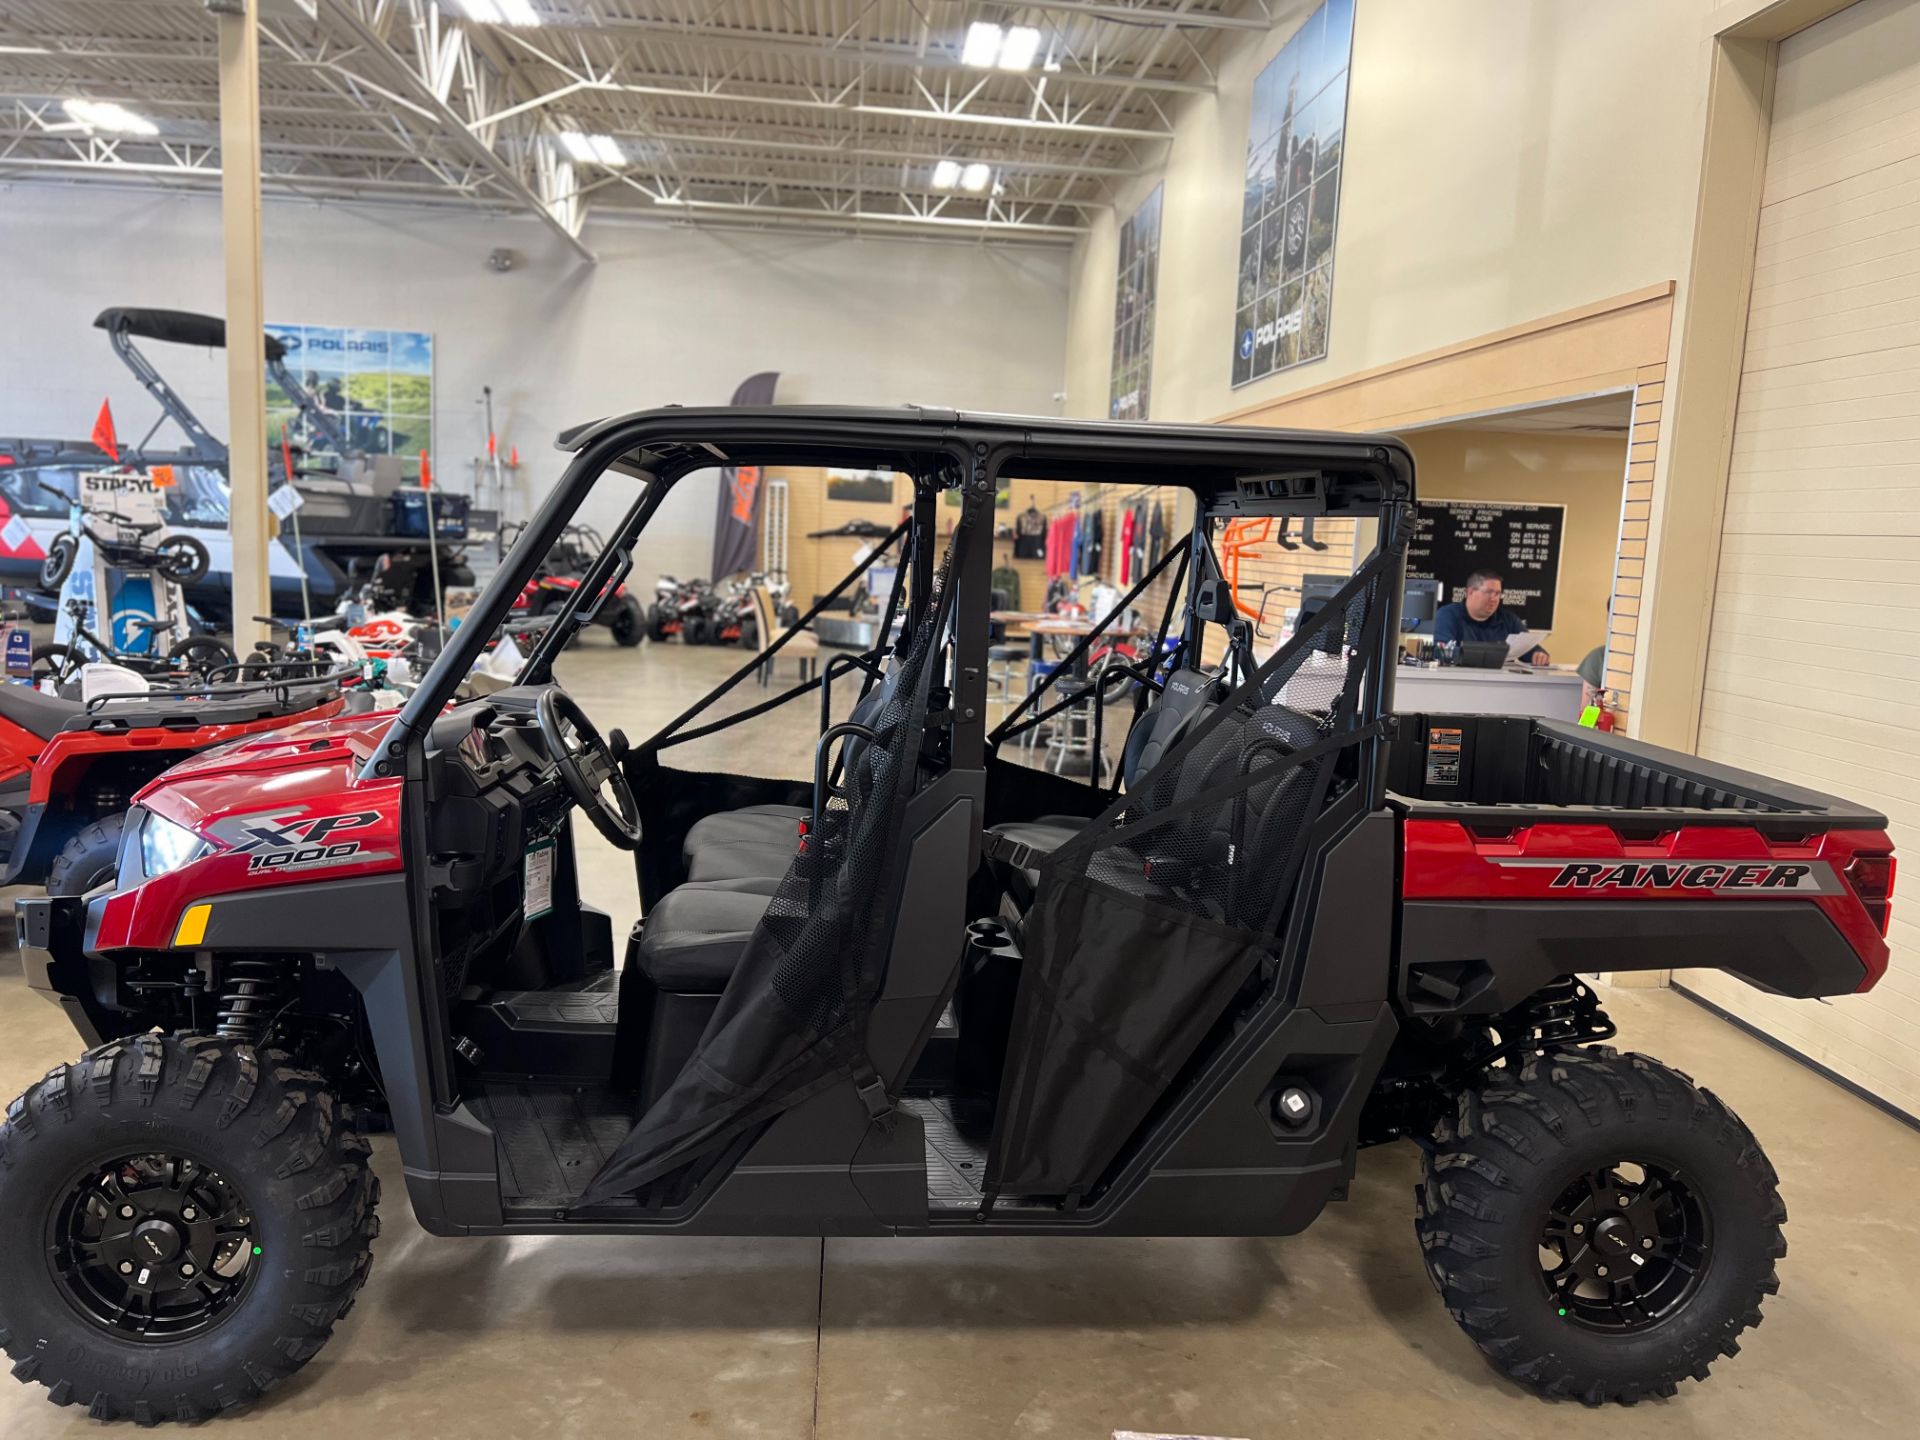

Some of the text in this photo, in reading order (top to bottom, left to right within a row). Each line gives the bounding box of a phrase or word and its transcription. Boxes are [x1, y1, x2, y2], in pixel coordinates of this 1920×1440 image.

[1256, 308, 1302, 349] POLARIS
[307, 338, 389, 353] POLARIS
[1472, 531, 1492, 539] PARTS
[1528, 562, 1542, 570] TIRE
[222, 810, 384, 855] XP
[249, 842, 360, 870] 1000
[1549, 862, 1813, 889] RANGER
